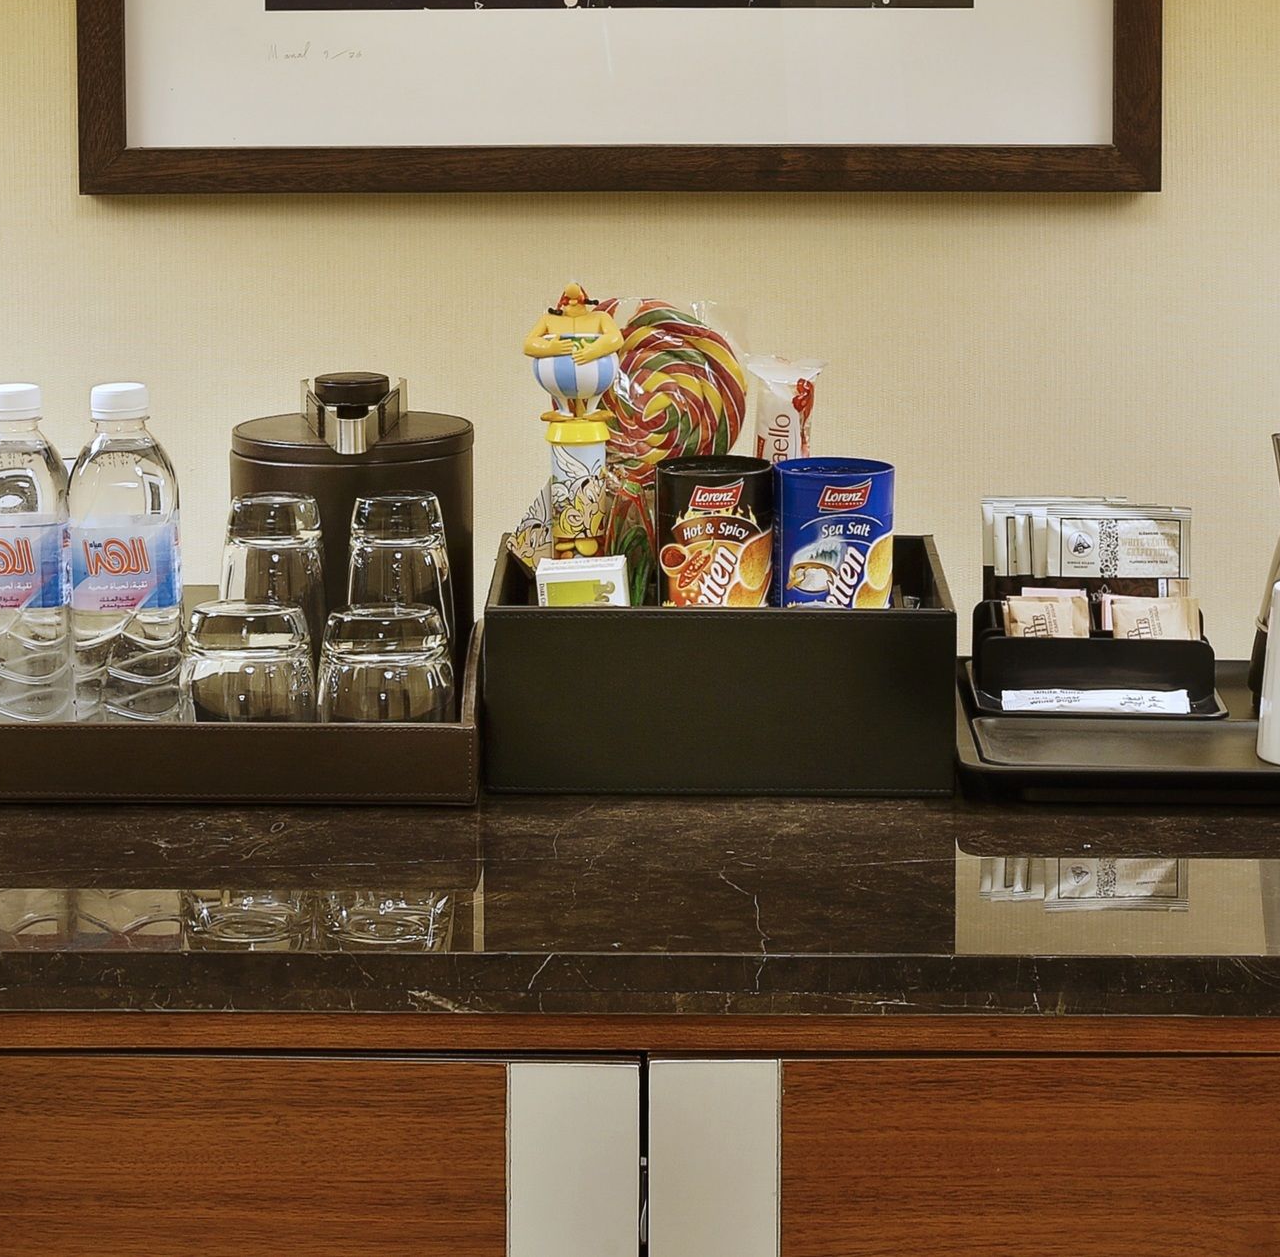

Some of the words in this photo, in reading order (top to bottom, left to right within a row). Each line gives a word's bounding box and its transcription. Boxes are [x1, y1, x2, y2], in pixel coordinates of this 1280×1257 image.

[695, 489, 736, 502] Lorenz
[824, 489, 864, 502] Lorenz
[683, 525, 704, 541] Hot
[705, 523, 715, 534] &
[718, 522, 750, 540] Spicy
[821, 523, 844, 539] Sea
[846, 522, 872, 537] Salt
